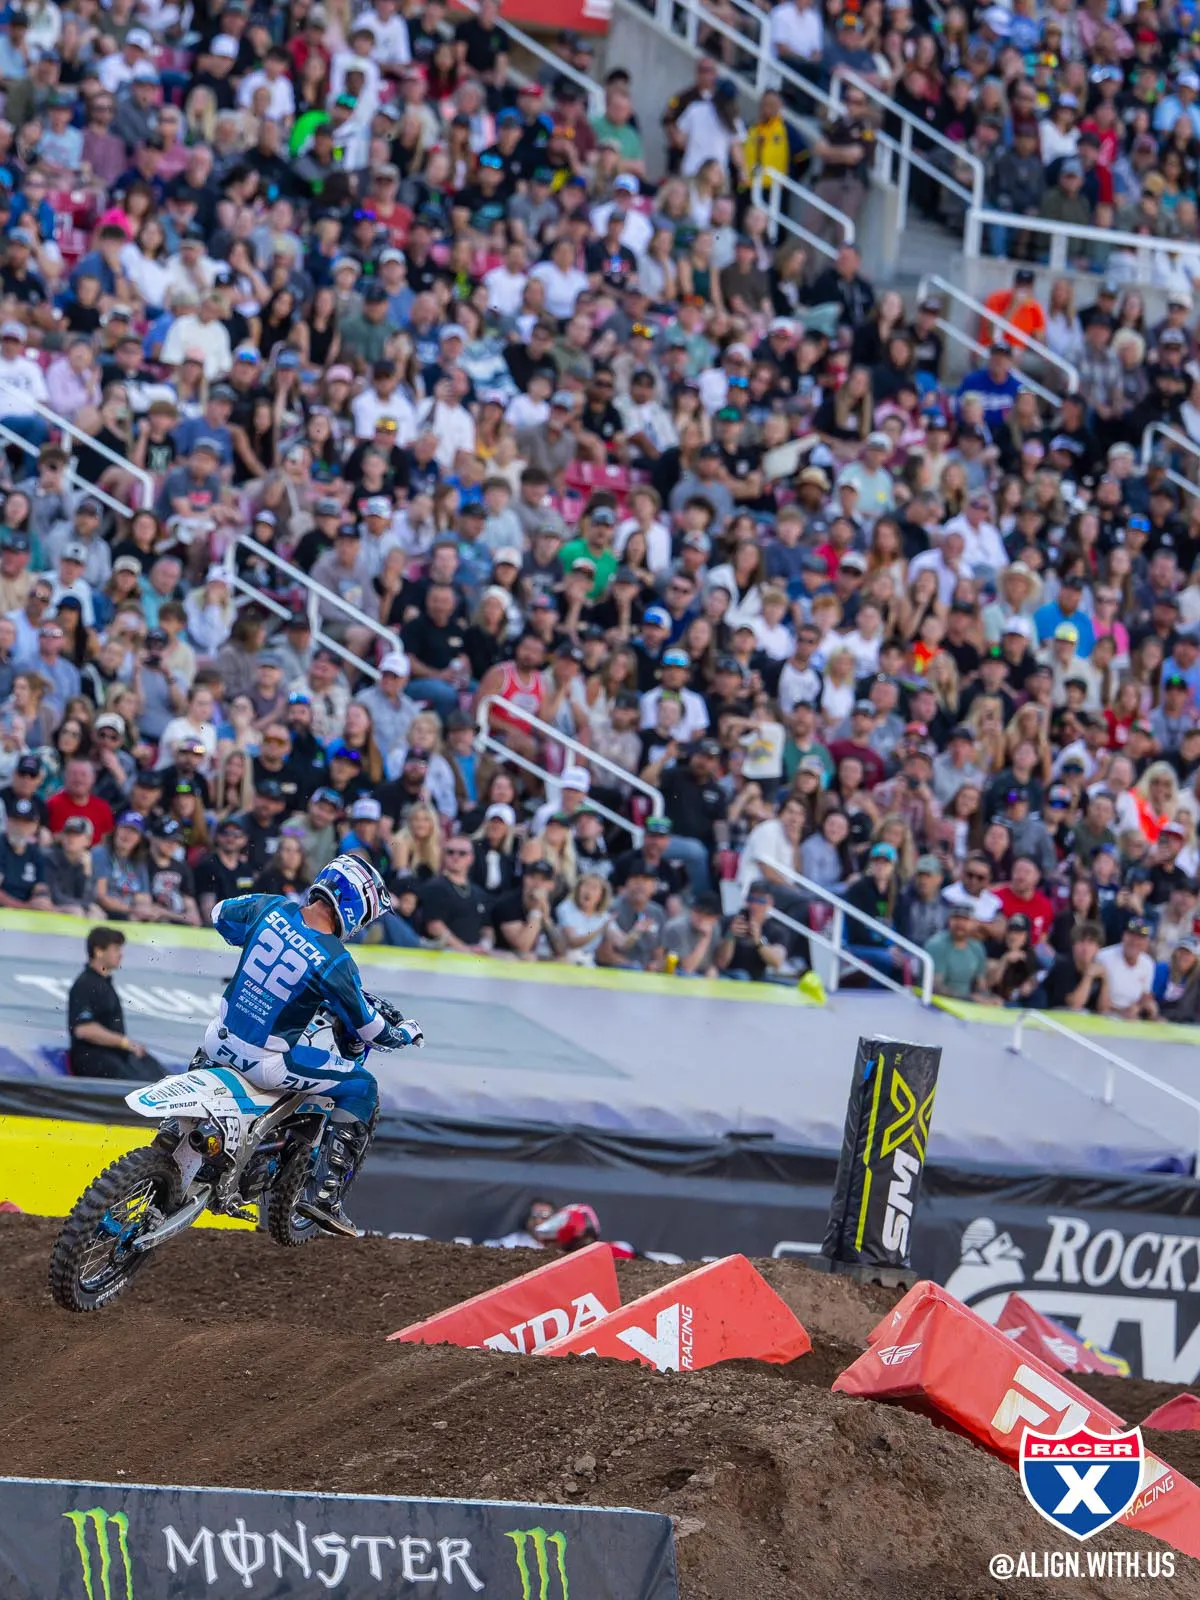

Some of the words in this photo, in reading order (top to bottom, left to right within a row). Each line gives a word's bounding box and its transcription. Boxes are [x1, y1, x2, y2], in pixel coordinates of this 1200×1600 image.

[242, 928, 309, 1002] 22
[264, 910, 327, 967] SCHOCK
[216, 1044, 260, 1073] FLY
[275, 1074, 321, 1092] FLY
[169, 1101, 198, 1110] DUNLOP
[1032, 1215, 1200, 1292] ROCK
[468, 1292, 608, 1355] NDA
[680, 1304, 695, 1370] RACING
[1123, 1475, 1176, 1521] RACING
